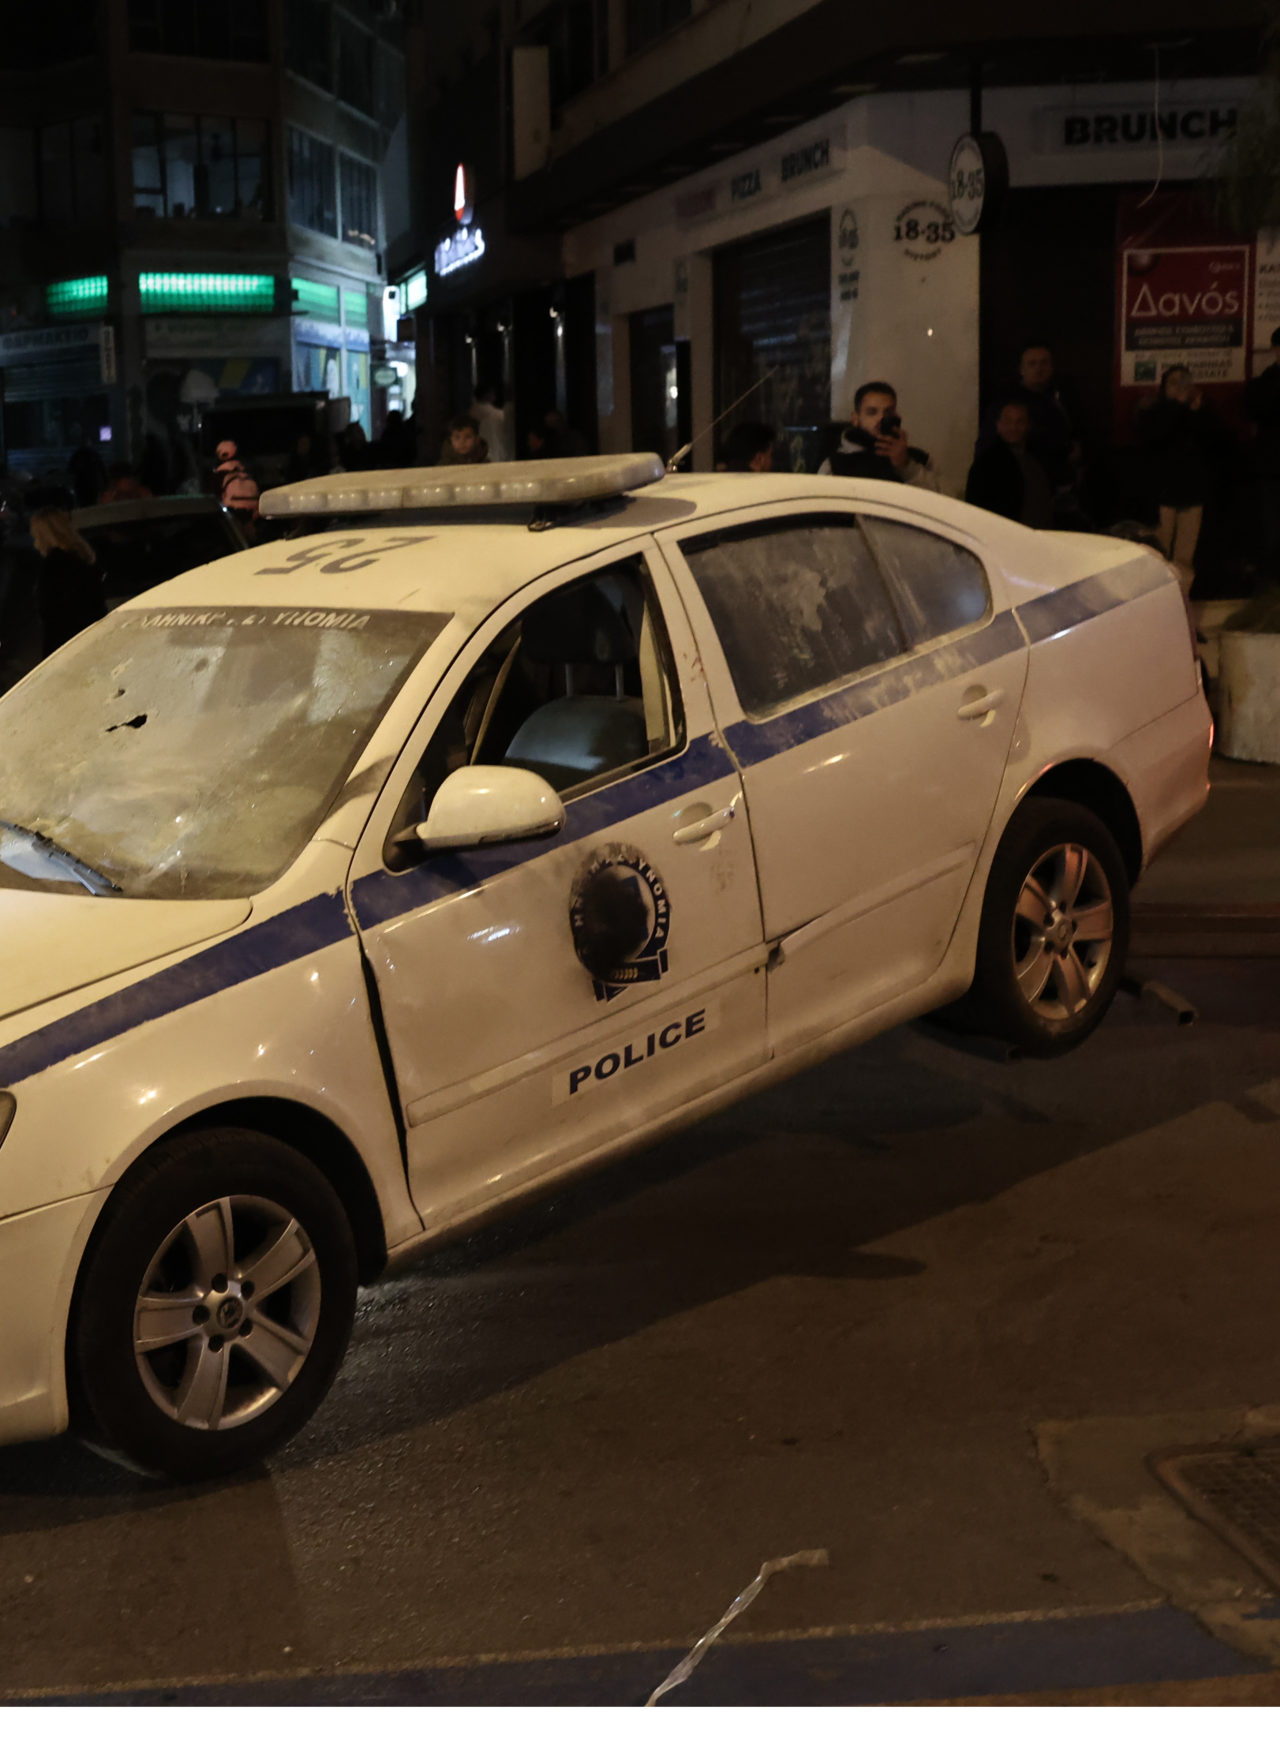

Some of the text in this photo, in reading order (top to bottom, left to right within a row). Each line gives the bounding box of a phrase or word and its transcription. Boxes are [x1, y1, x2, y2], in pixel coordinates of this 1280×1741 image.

[1065, 108, 1237, 145] BRUNCH
[782, 139, 829, 181] BRUNCH
[569, 1008, 706, 1095] POLICE
